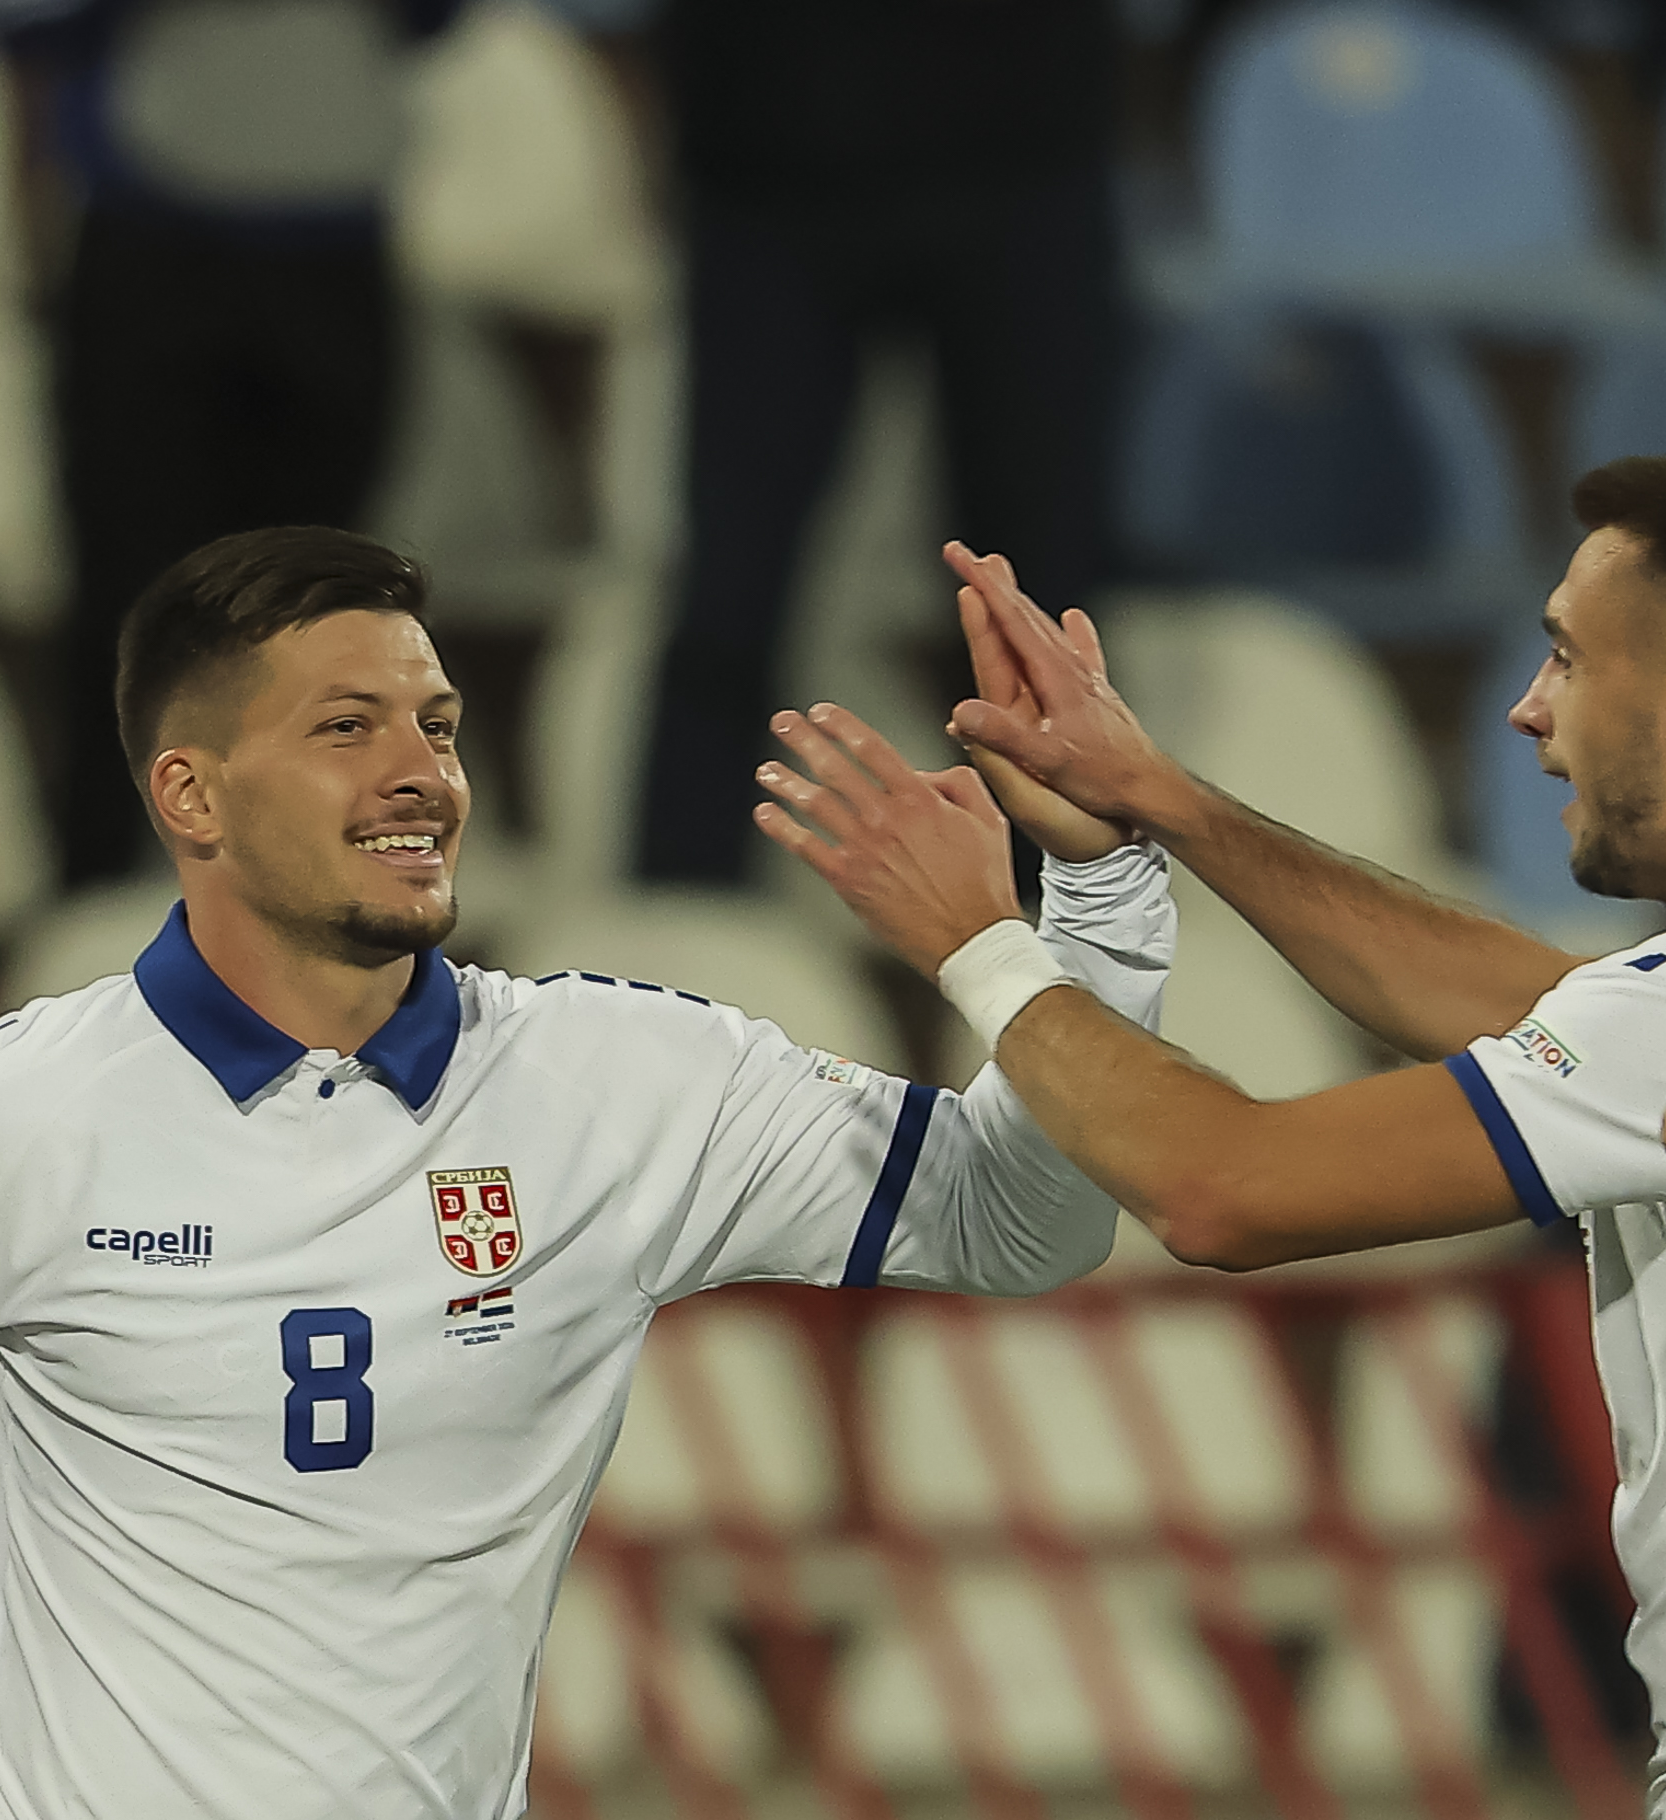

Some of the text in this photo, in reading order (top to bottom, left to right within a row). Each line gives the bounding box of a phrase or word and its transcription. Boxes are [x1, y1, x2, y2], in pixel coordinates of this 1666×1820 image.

[430, 1168, 507, 1184] СРБИЈА
[85, 1223, 214, 1261] capelli
[143, 1254, 213, 1269] SPORT
[278, 1307, 374, 1474] 8
